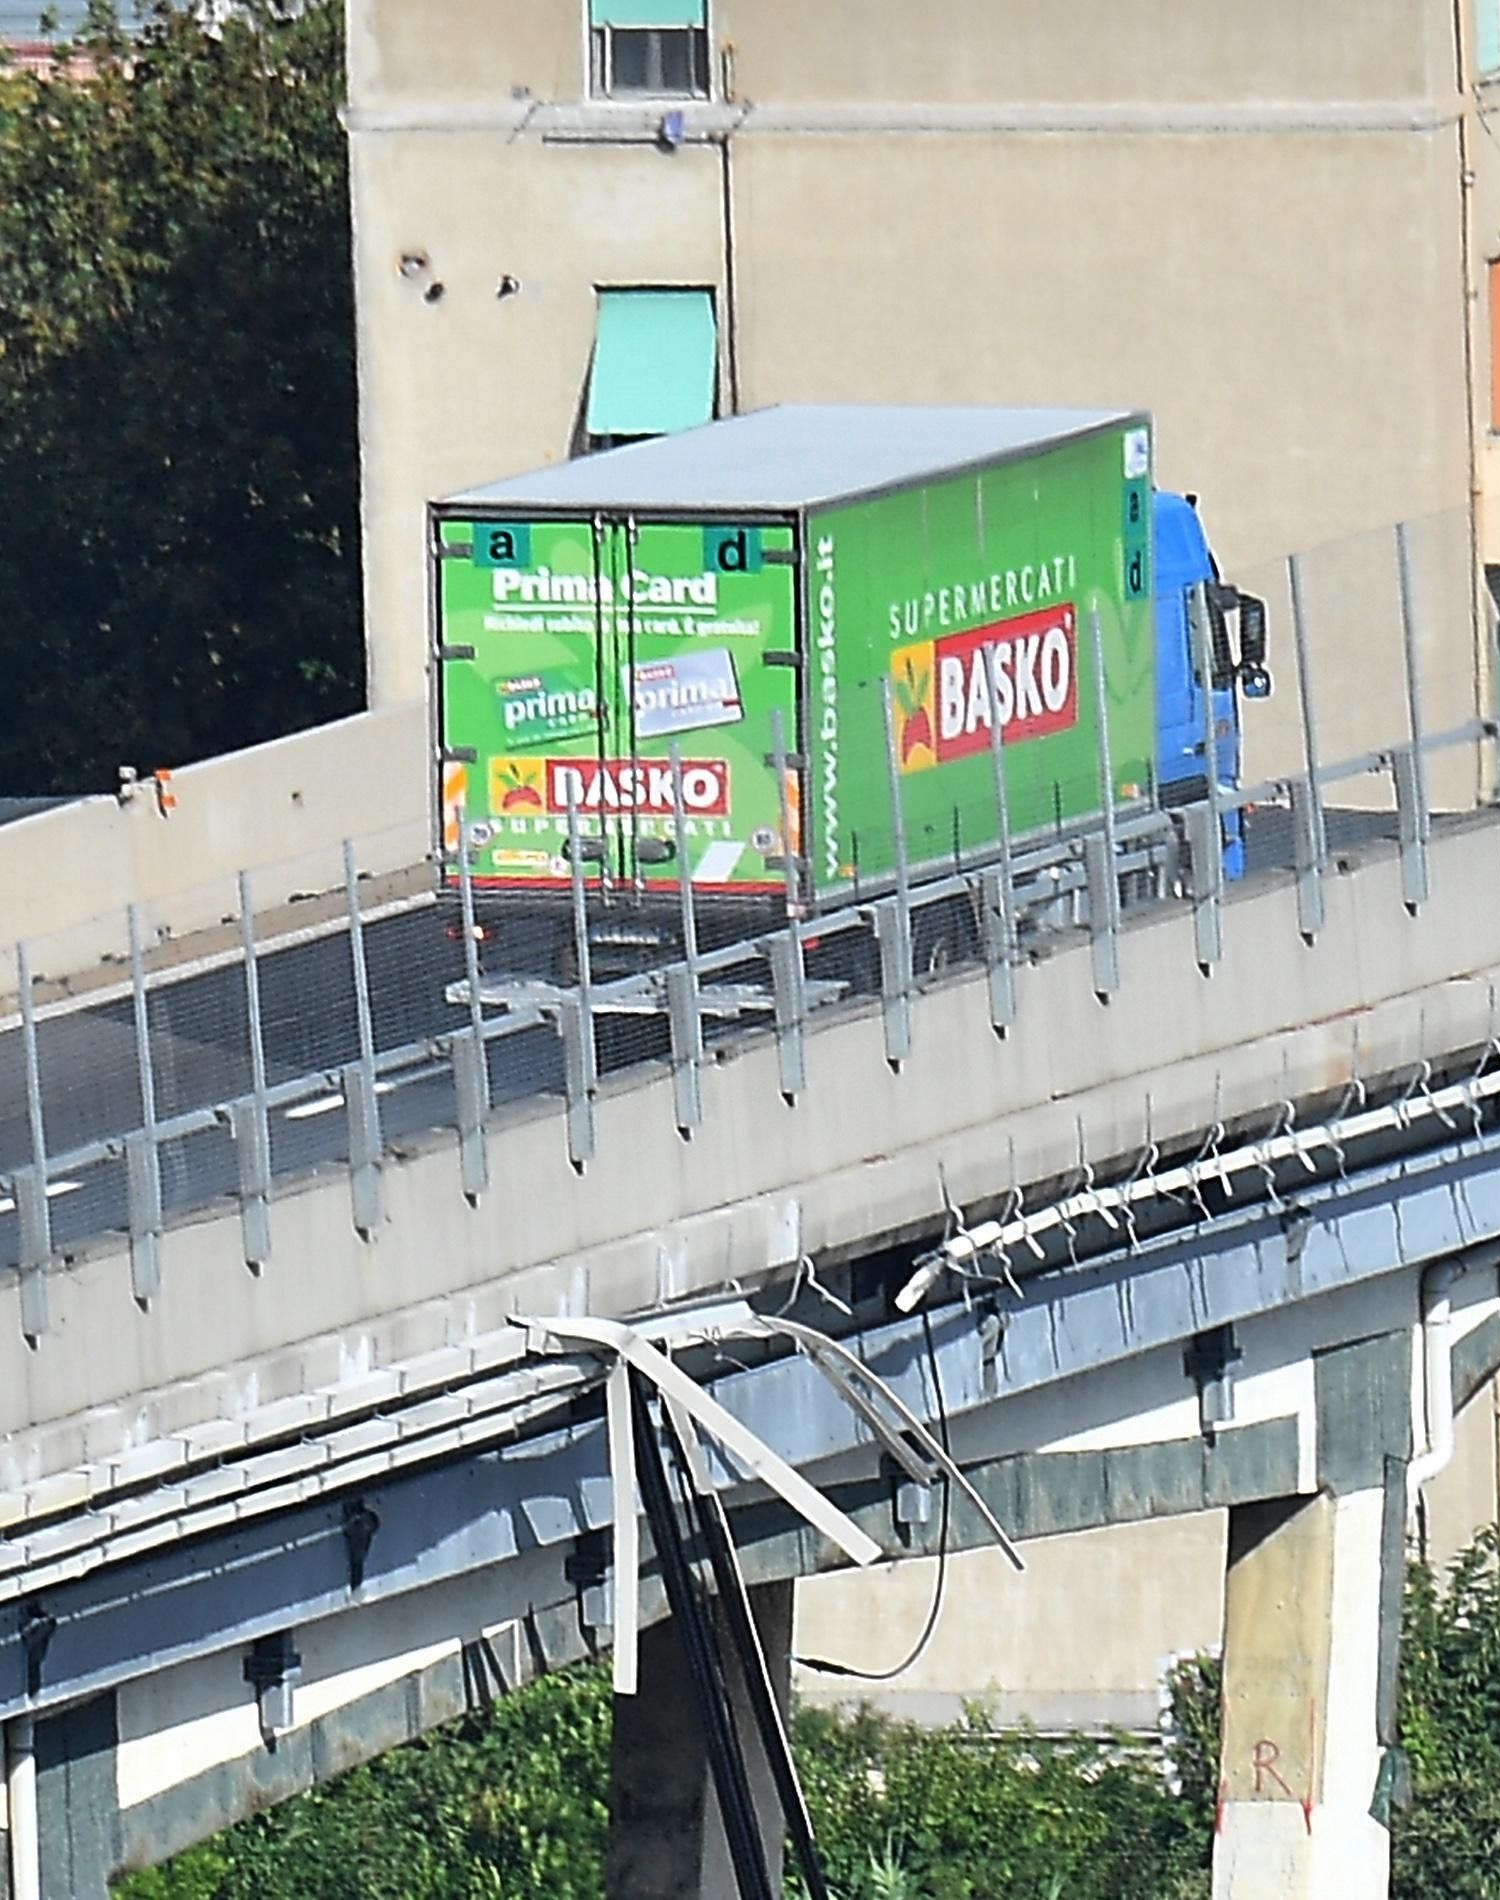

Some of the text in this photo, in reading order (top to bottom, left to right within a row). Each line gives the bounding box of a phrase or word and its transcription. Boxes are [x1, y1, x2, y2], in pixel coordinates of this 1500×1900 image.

[489, 531, 516, 561] a
[717, 530, 748, 572] d
[492, 566, 717, 606] Prima Card
[888, 555, 1077, 640] SUPERMERCATI
[940, 627, 1070, 740] BASKO
[504, 687, 597, 730] prima
[816, 534, 839, 878] www.basko.it
[553, 766, 720, 809] BASKO
[1252, 1739, 1292, 1796] R
